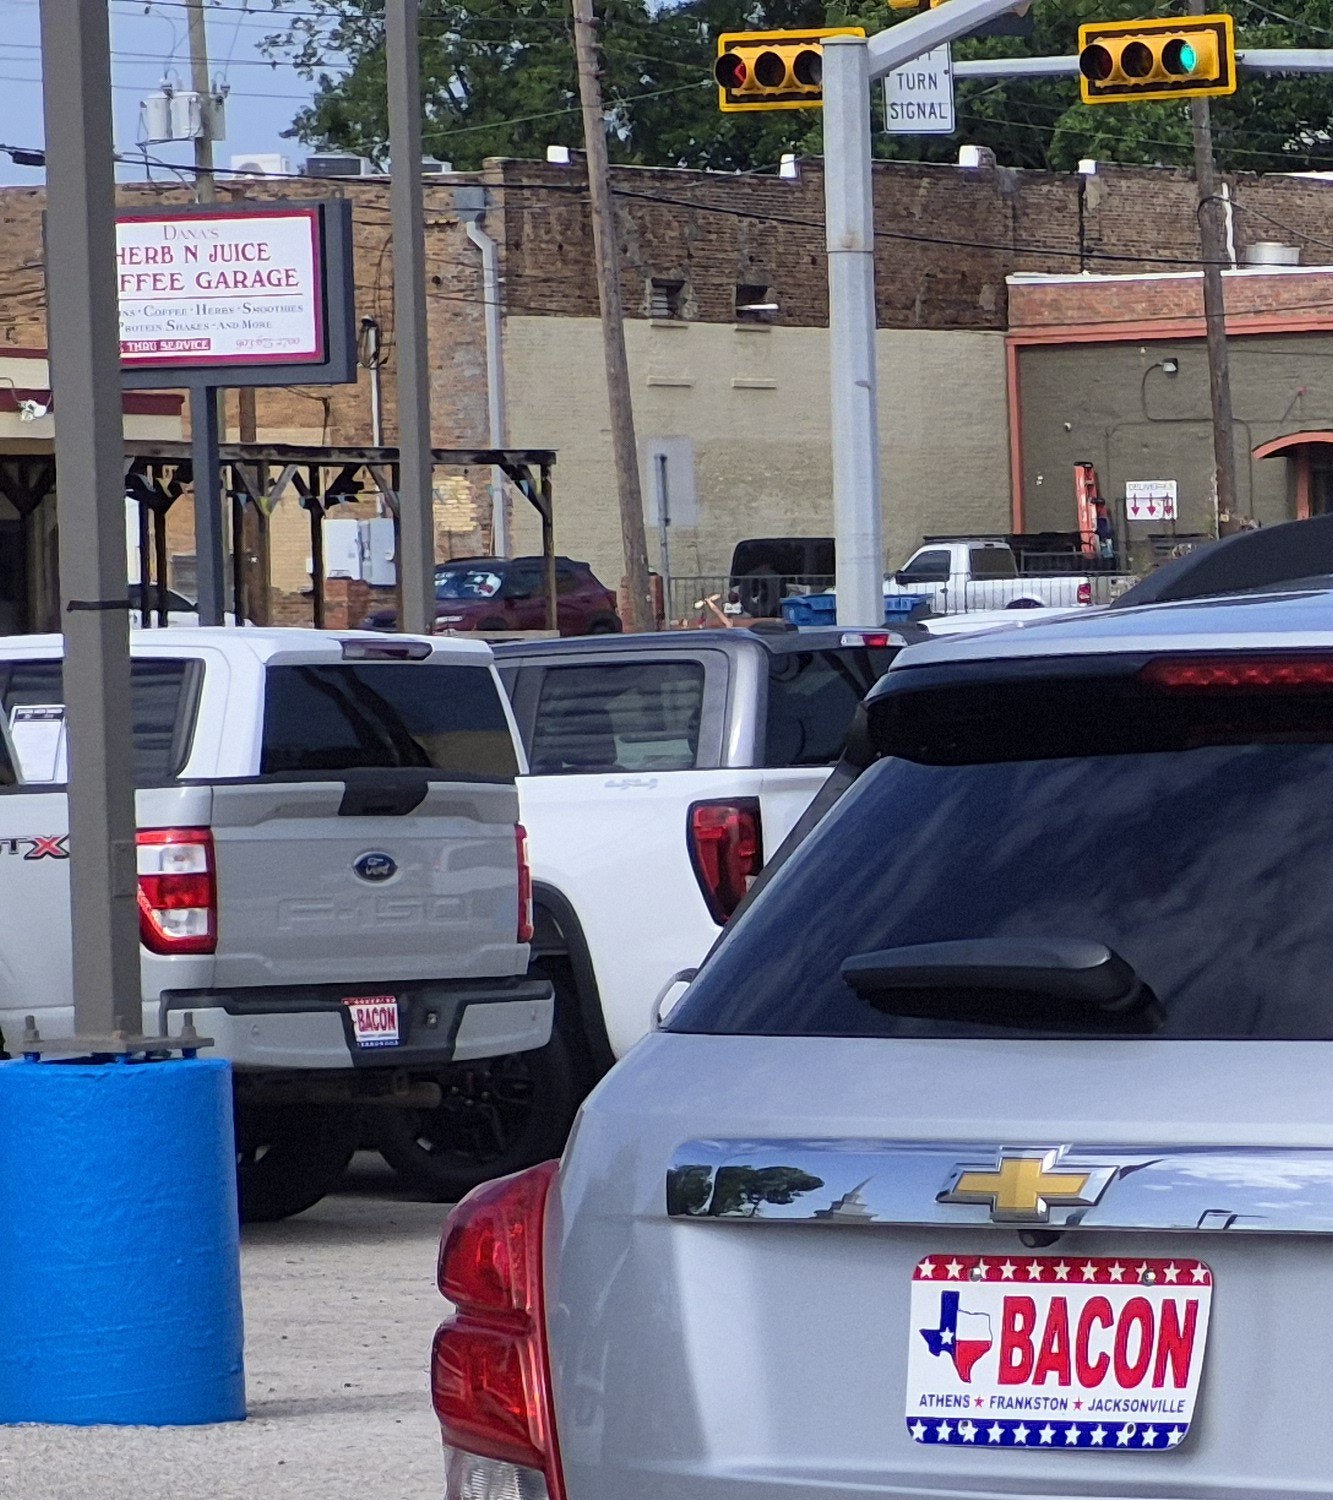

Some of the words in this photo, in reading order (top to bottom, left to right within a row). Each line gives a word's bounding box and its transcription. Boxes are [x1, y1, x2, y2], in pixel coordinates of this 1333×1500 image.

[896, 72, 938, 91] TURN
[890, 101, 948, 119] SIGNAL
[116, 245, 174, 266] HERB
[184, 244, 199, 264] N
[209, 242, 272, 263] JUICE
[119, 272, 186, 293] FFEE
[195, 267, 300, 290] GARAGE
[127, 340, 158, 353] THRU
[160, 338, 210, 351] SERVICE
[0, 834, 70, 860] TX
[356, 1006, 397, 1033] BACON
[998, 1295, 1199, 1389] BACON
[919, 1393, 971, 1409] ATHENS
[989, 1395, 1068, 1411] FRANKSTON
[1087, 1397, 1187, 1414] JACKSONVILLE
